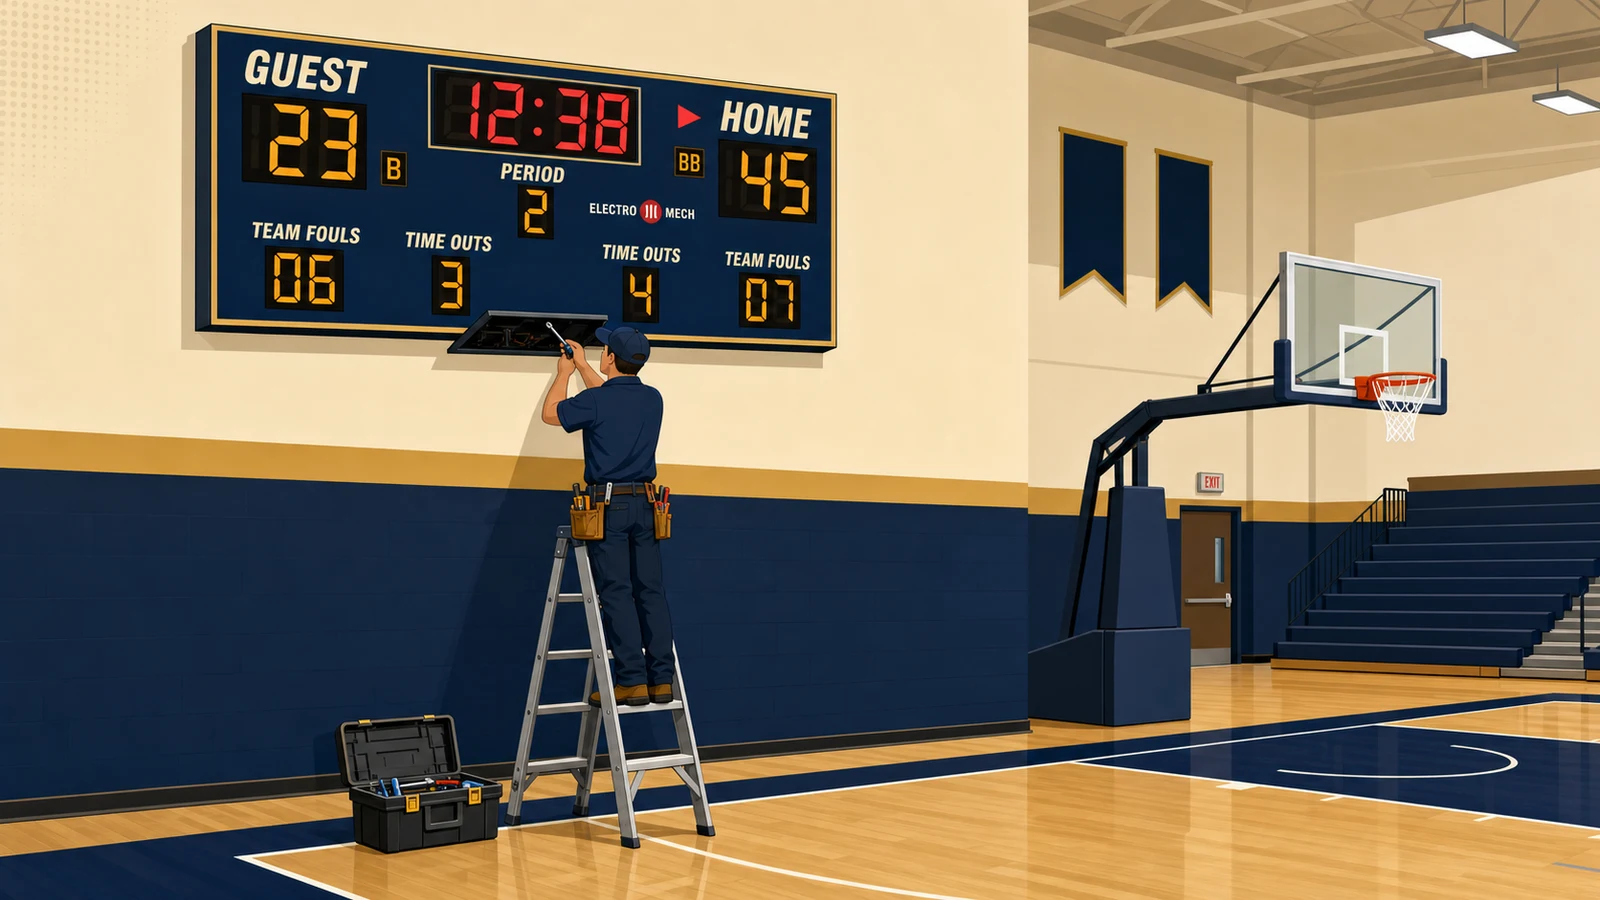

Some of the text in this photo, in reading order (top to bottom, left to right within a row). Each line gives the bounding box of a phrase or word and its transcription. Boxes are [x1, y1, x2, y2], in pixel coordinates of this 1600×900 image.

[244, 48, 368, 94] GUEST
[469, 80, 630, 155] 12:38
[720, 100, 812, 140] HOME
[268, 103, 358, 181] 23
[386, 156, 401, 181] B
[500, 162, 565, 184] PERIOD
[679, 152, 701, 173] BB
[740, 150, 810, 216] 45
[524, 189, 548, 234] 2
[589, 202, 695, 220] ELECTRO MECH
[252, 221, 361, 244] TEAM FOULS
[405, 231, 493, 252] TIME OUTS
[602, 243, 681, 264] TIME OUTS
[725, 251, 811, 271] TEAM FOULS
[273, 252, 336, 305] 06
[440, 260, 463, 309] 3
[629, 273, 652, 316] 4
[745, 277, 794, 323] 07
[1204, 475, 1221, 489] EXIT
